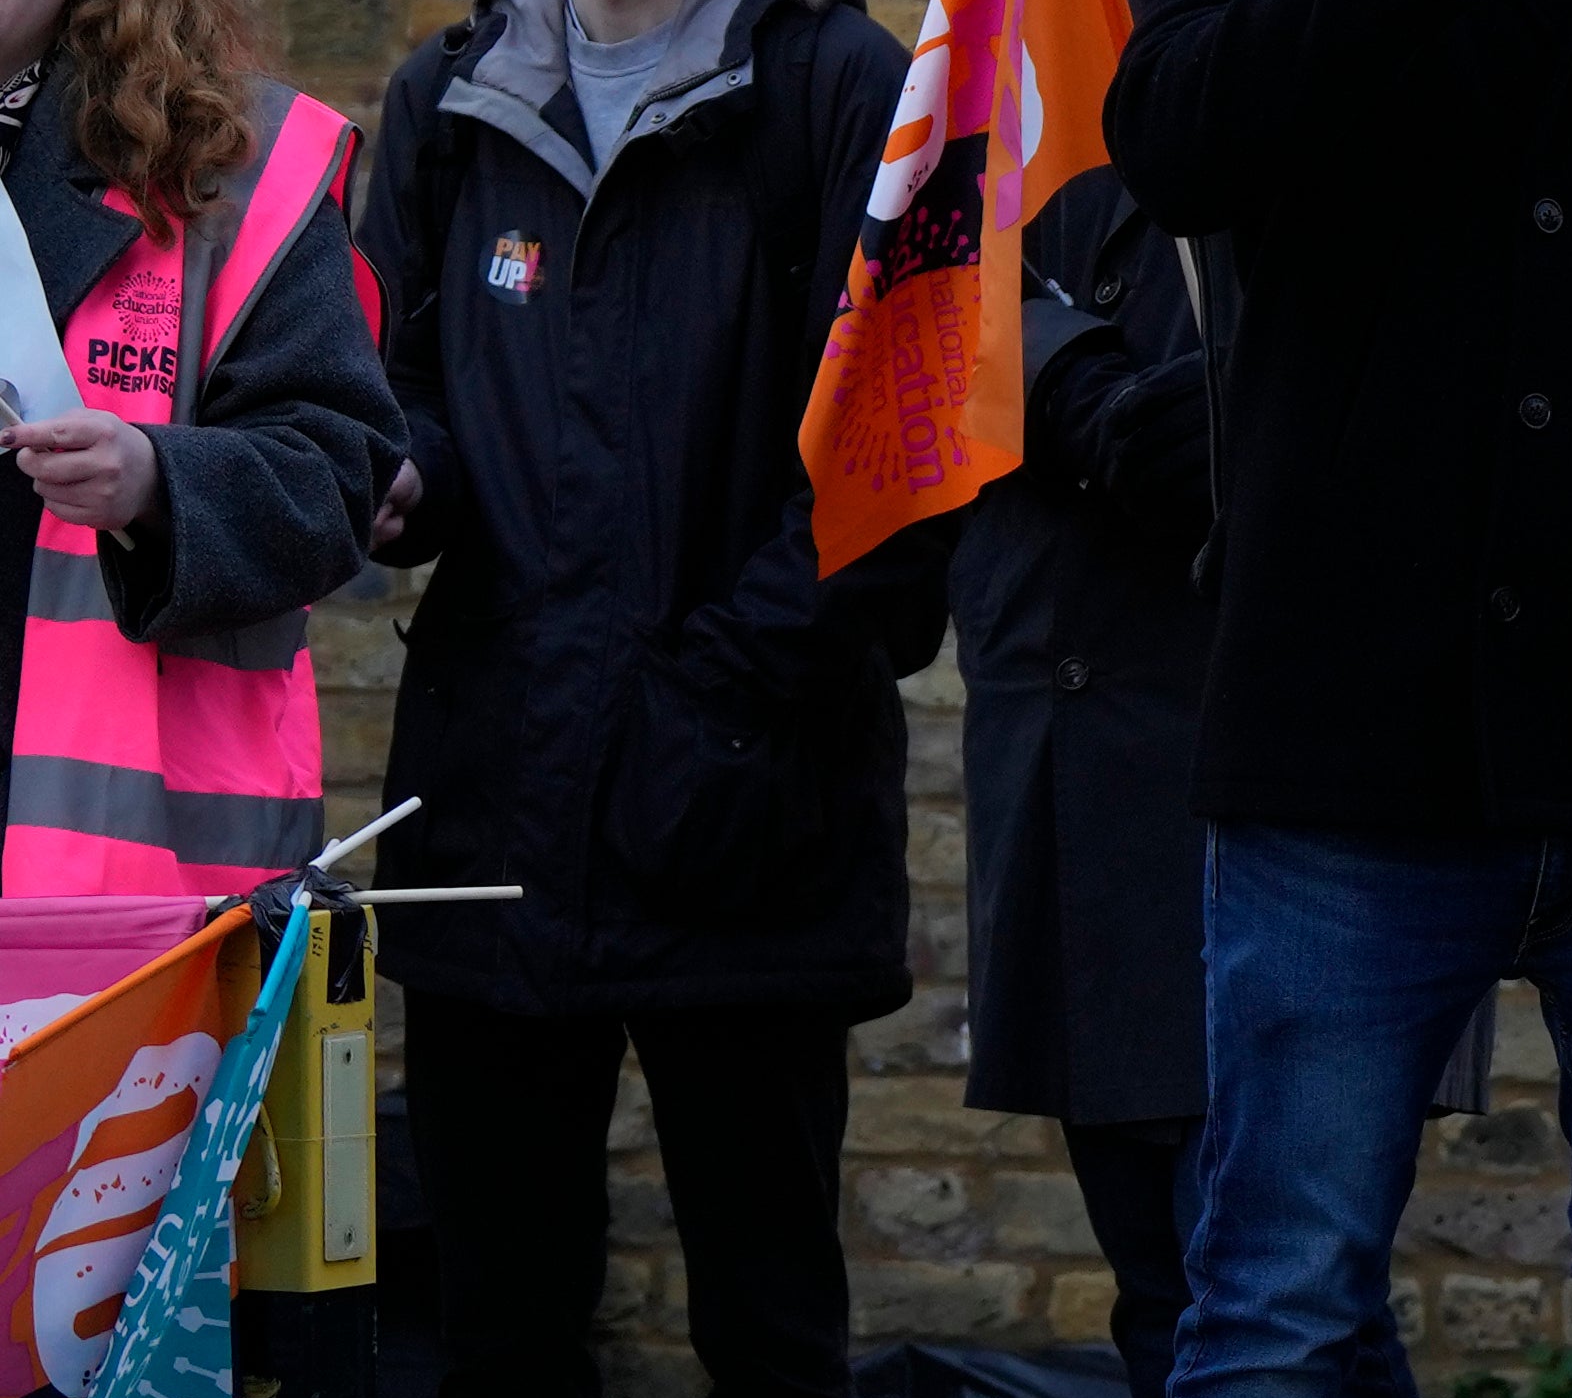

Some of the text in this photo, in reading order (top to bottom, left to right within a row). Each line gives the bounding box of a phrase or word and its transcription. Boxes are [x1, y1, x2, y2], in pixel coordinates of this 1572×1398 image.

[494, 237, 541, 262] PAY
[487, 252, 541, 292] UP!
[88, 338, 177, 377] PICKE
[87, 366, 175, 399] SUPERVISO
